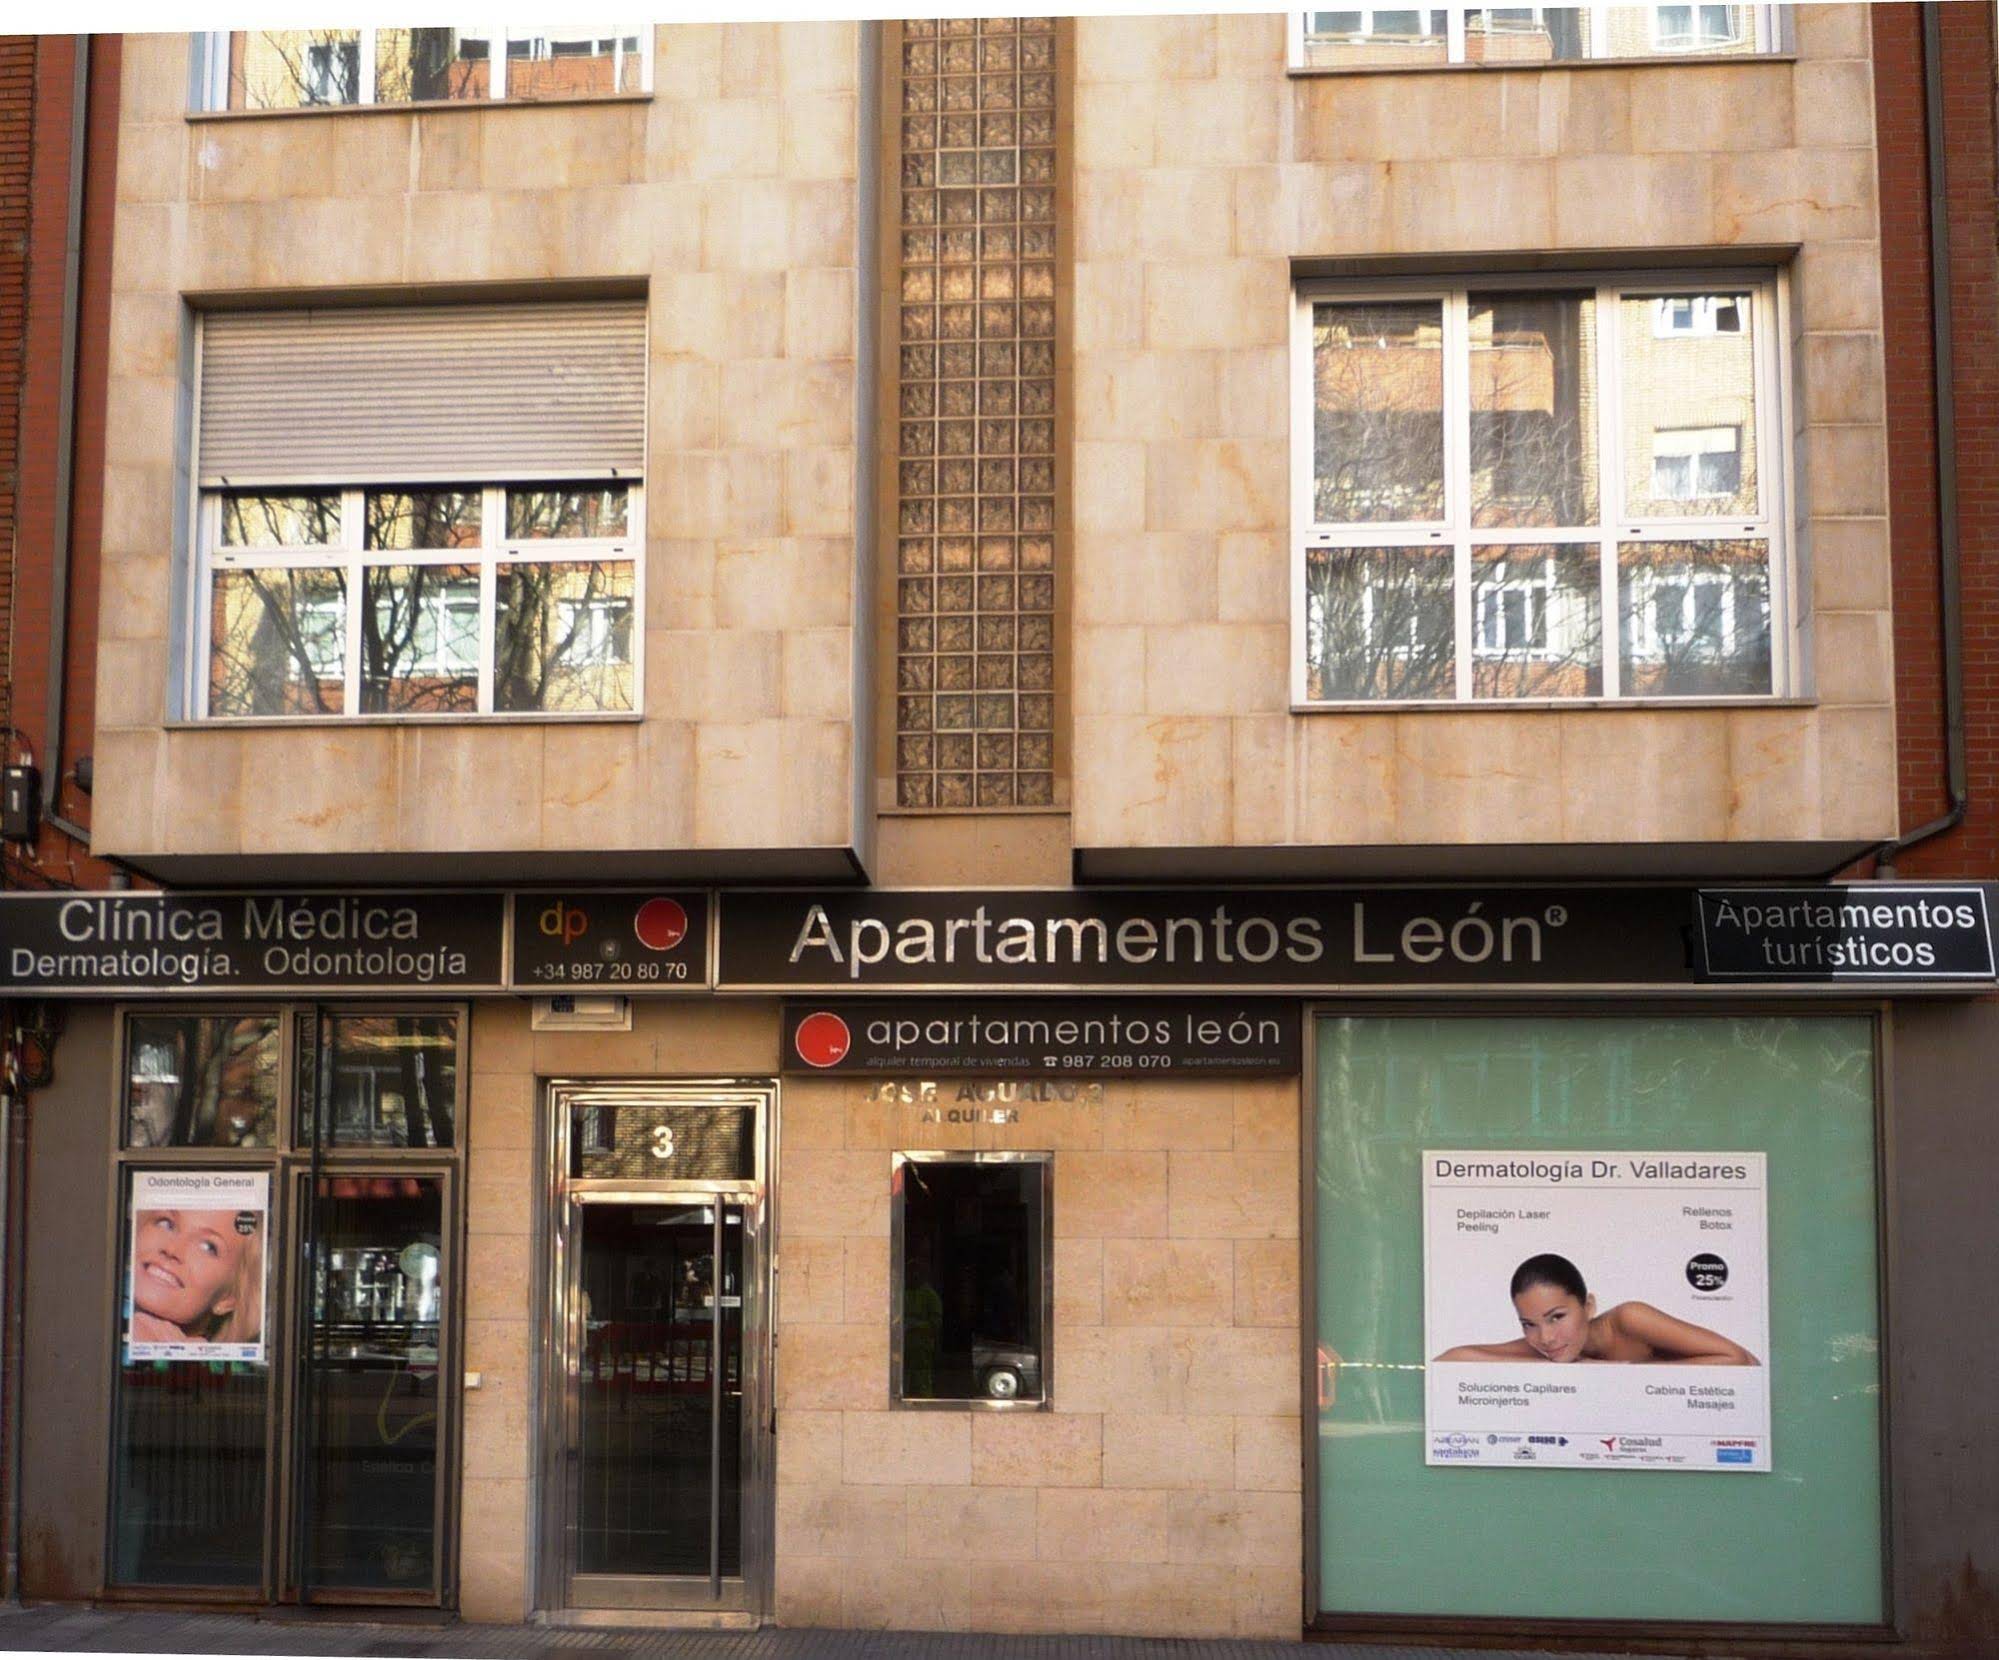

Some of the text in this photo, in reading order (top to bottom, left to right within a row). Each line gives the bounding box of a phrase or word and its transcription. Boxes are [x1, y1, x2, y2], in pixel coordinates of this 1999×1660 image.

[59, 898, 419, 941] Clínica Médica
[1715, 898, 1975, 931] Apartamentos
[540, 900, 588, 945] dp
[789, 904, 1324, 979] Apartamentos
[1763, 934, 1935, 967] turísticos
[11, 946, 467, 983] Dermatología. Odontología
[533, 962, 687, 979] +34 987 20 80 70
[867, 1012, 1280, 1051] apartamentos león
[866, 1056, 905, 1068] alquiler
[910, 1056, 960, 1068] temporal
[963, 1055, 977, 1067] de
[980, 1055, 1031, 1067] viviendas
[1063, 1055, 1094, 1068] 987
[1100, 1055, 1133, 1068] 208
[1138, 1055, 1171, 1068] 070
[652, 1126, 674, 1159] 3
[1436, 1160, 1747, 1182] Dermatología Dr. Valladares
[148, 1176, 255, 1189] Odontología General
[1457, 1209, 1551, 1222] Depilación Laser
[1682, 1207, 1732, 1217] Rellenos
[1457, 1222, 1499, 1234] Peeling
[1699, 1220, 1732, 1230] Botox
[1690, 1261, 1724, 1270] Promo
[1695, 1274, 1724, 1286] 25%
[1458, 1383, 1577, 1396] Soluciones Capilares
[1645, 1385, 1735, 1397] Cabina Estética
[1458, 1395, 1529, 1408] Microinjertos
[1687, 1399, 1735, 1411] Masajes
[1619, 1437, 1662, 1447] Cosalud
